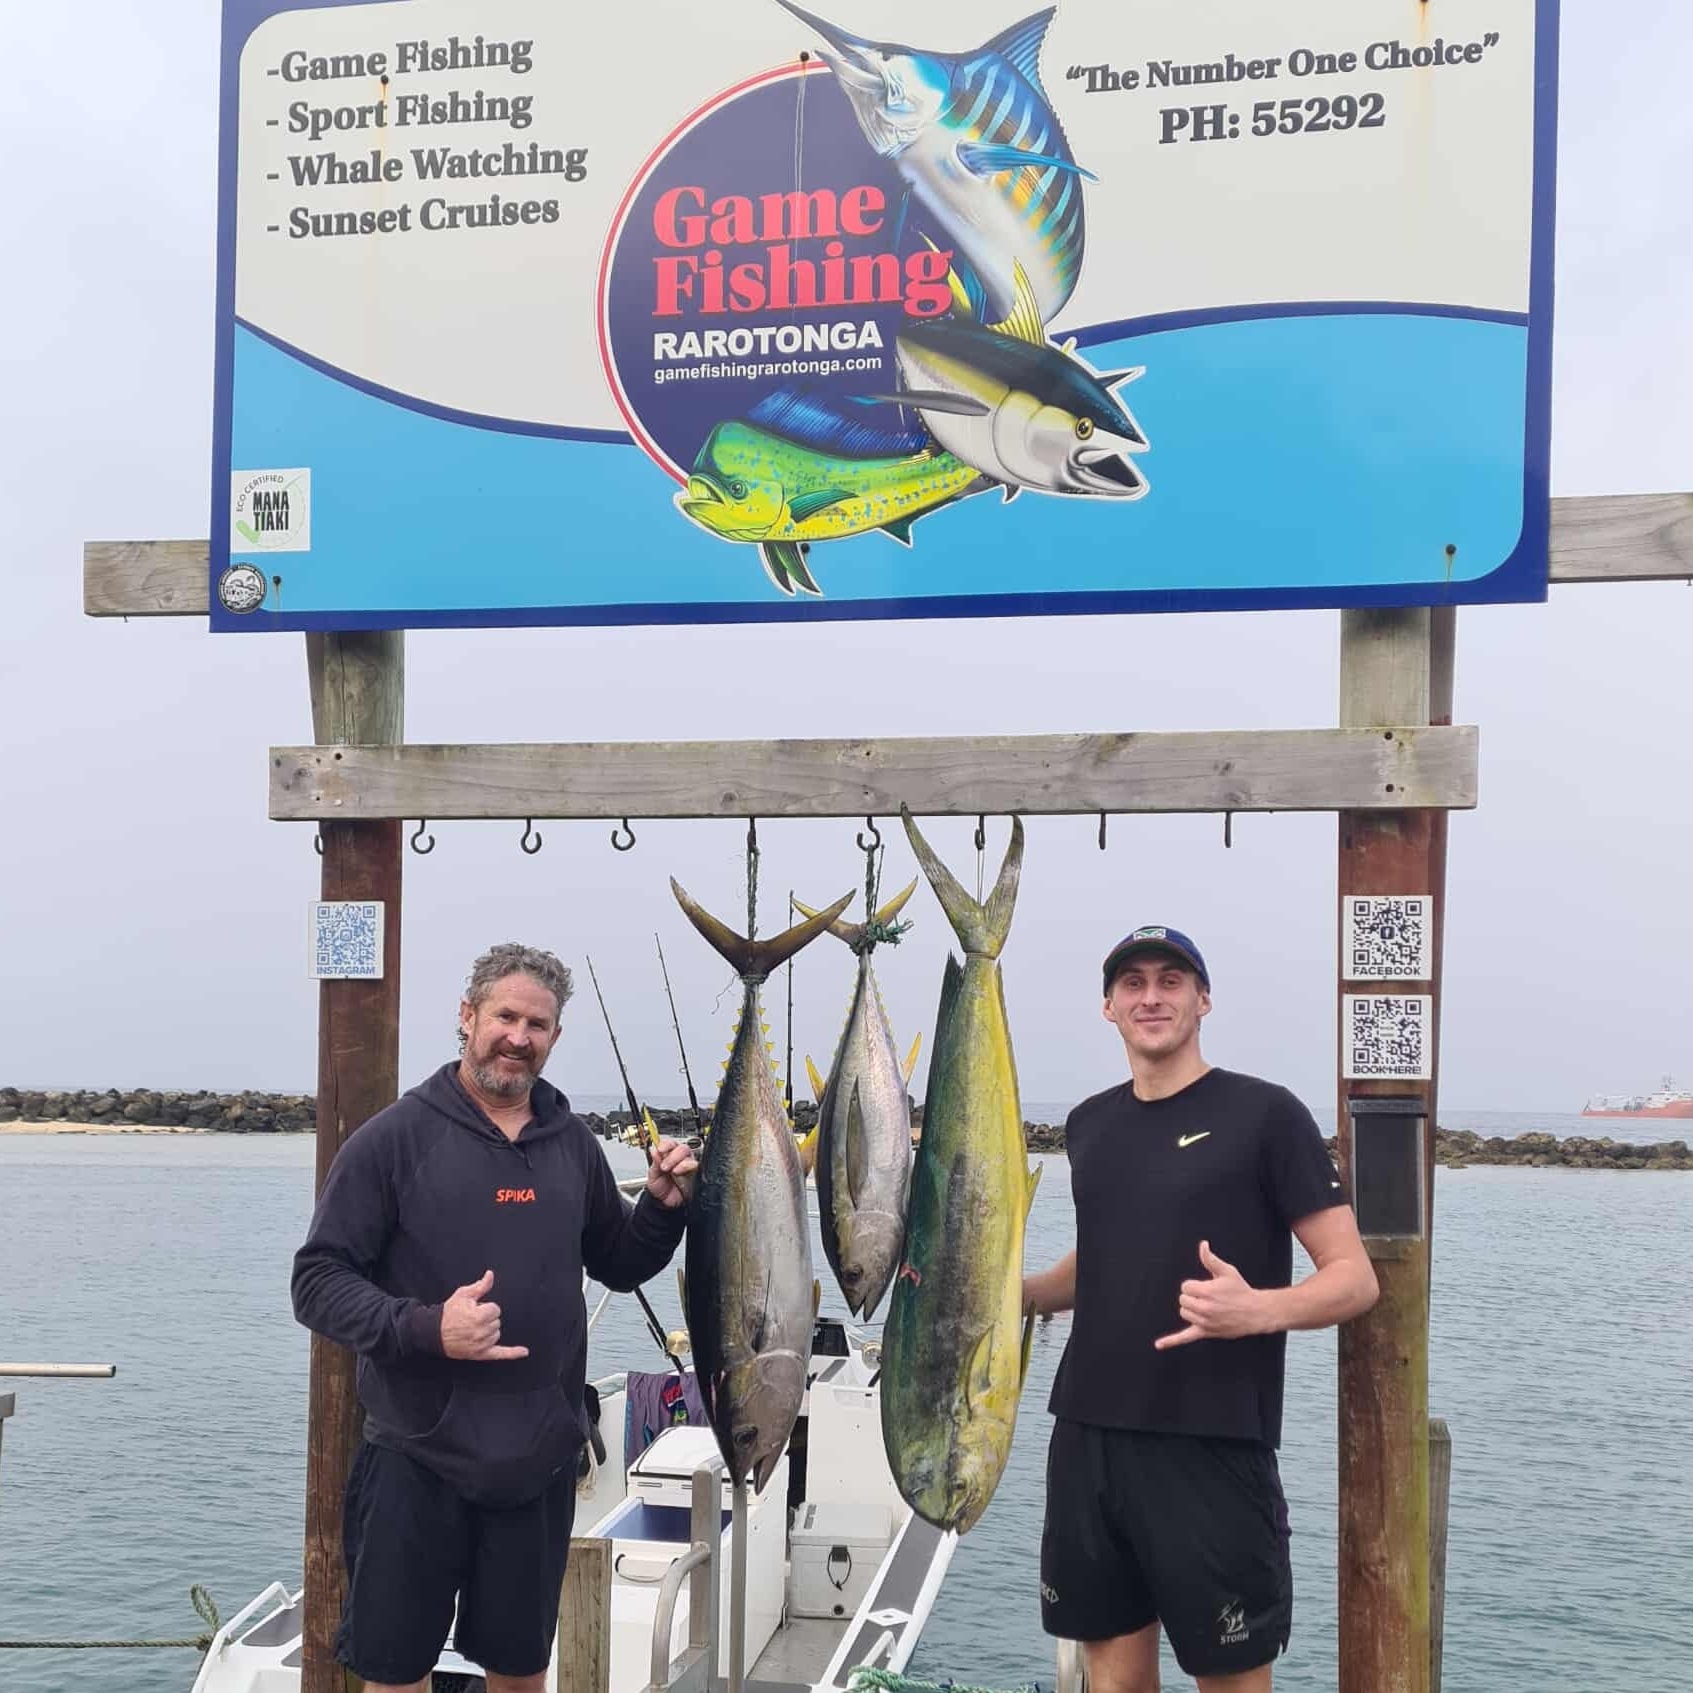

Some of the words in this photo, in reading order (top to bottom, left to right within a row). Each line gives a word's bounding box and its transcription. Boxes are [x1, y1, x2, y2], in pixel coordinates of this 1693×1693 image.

[395, 35, 534, 73] Fishing
[1146, 54, 1281, 88] Number
[1288, 48, 1357, 77] One
[288, 100, 388, 140] Sport
[395, 90, 533, 128] Fishing
[1158, 103, 1240, 144] PH:
[1251, 92, 1386, 137] 55292
[287, 150, 402, 186] Whale
[411, 142, 588, 181] Watching
[288, 204, 411, 238] Sunset
[419, 194, 560, 230] Cruises
[653, 185, 885, 248] Game
[652, 241, 954, 318] Fishing
[653, 320, 884, 360] RAROTONGA
[654, 356, 882, 384] gamefishingrarotonga.com
[244, 474, 284, 494] CERTIFIED
[253, 491, 290, 511] MANA
[253, 511, 289, 532] TIAKI
[316, 966, 376, 975] INSTAGRAM
[1353, 966, 1421, 976] FACEBOOK
[1353, 1065, 1386, 1074] BOOK
[496, 1188, 536, 1203] SPIKA
[1220, 1632, 1249, 1644] STORM
